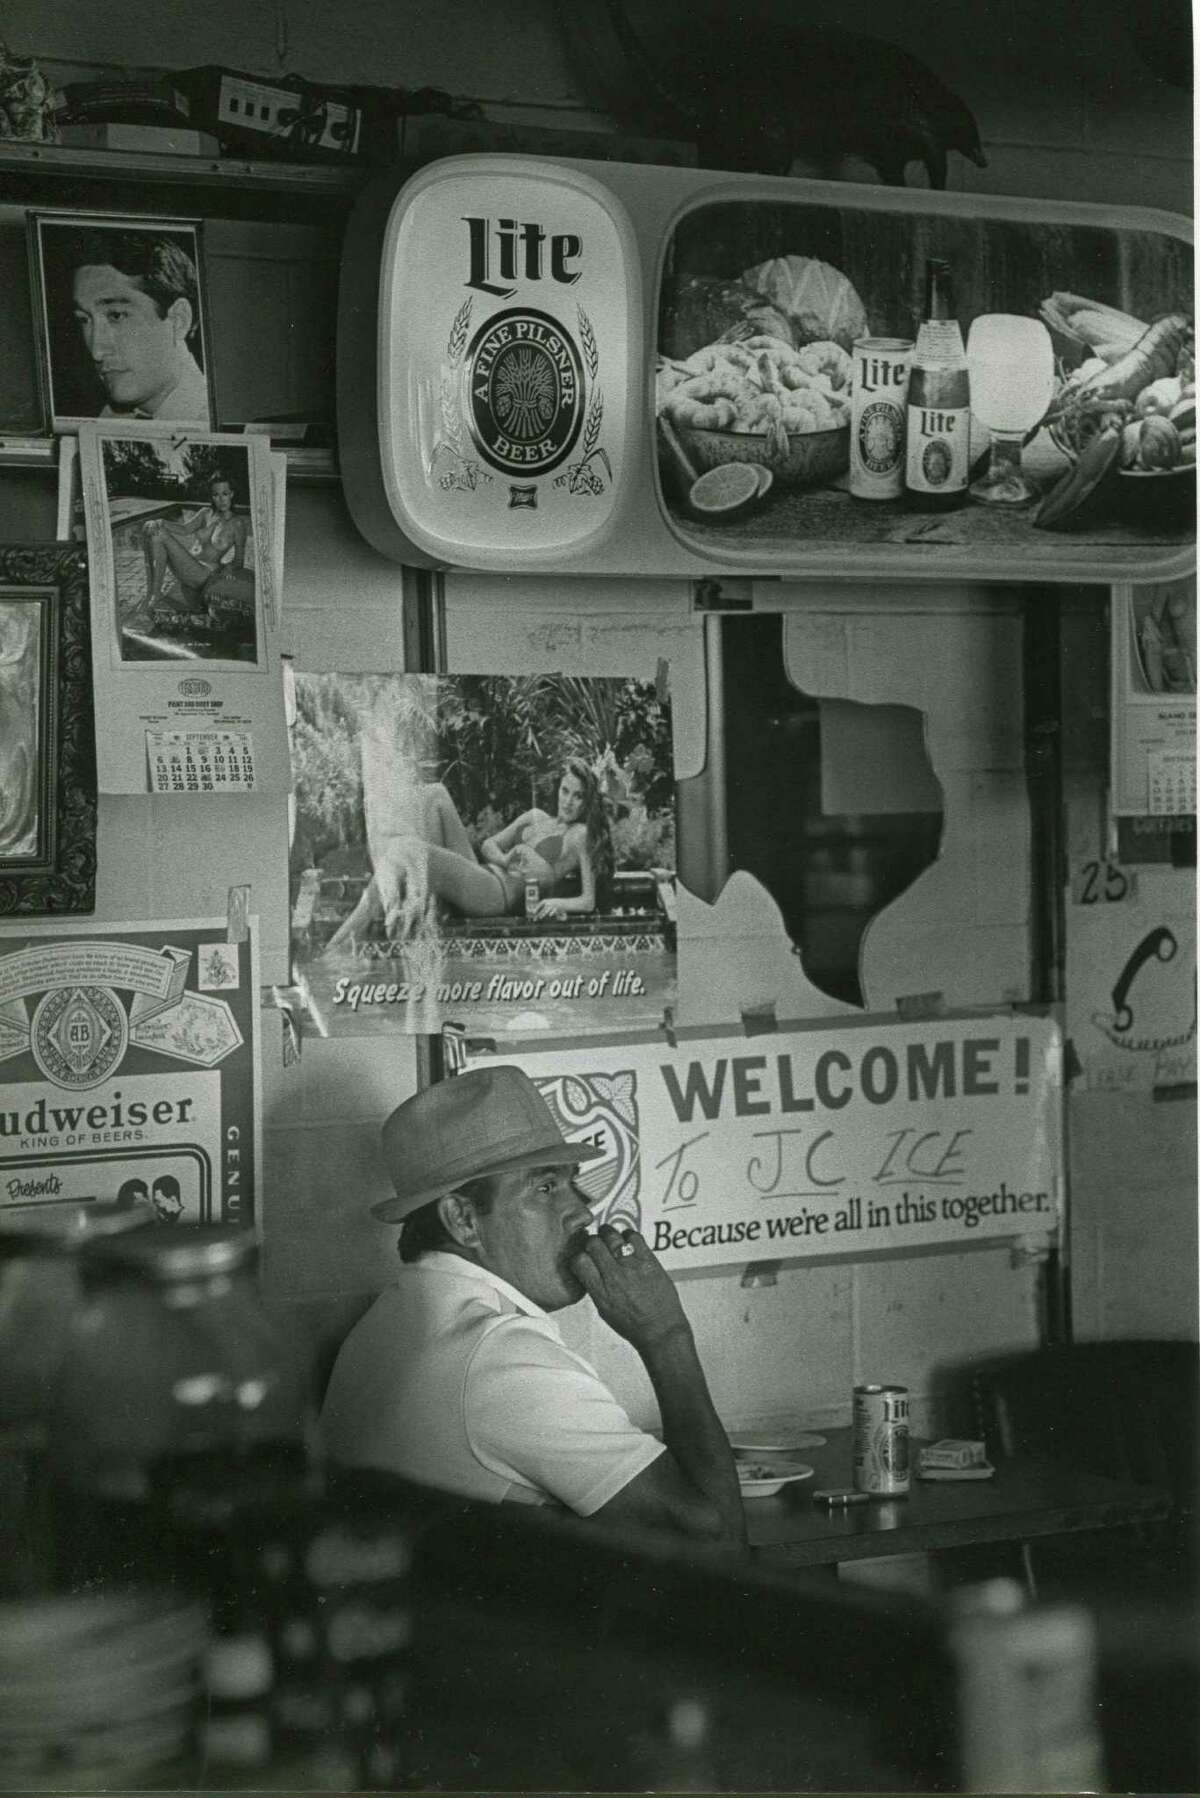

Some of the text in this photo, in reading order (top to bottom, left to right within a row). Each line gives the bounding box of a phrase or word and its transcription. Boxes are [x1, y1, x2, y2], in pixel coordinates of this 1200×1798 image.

[460, 217, 583, 299] Lite
[474, 322, 577, 408] A FINE PILSNER
[860, 357, 905, 392] Lite
[920, 410, 956, 437] Lite
[491, 435, 557, 462] BEER
[214, 756, 224, 764] 10
[229, 756, 238, 764] 11
[242, 756, 252, 764] 12
[229, 747, 235, 755] 4
[157, 765, 167, 773] 13
[171, 765, 182, 773] 14
[186, 765, 196, 773] 15
[200, 765, 211, 773] 16
[158, 774, 254, 782] 20 21 22 24 25 26
[158, 783, 213, 791] 27 28 29 30
[333, 970, 646, 1011] Squeeze more flavor out of life.
[660, 1037, 1030, 1123] WELCOME!
[0, 1090, 192, 1136] udweiser
[20, 1135, 60, 1149] KING
[66, 1132, 87, 1145] OF
[656, 1132, 710, 1204] To
[872, 1128, 973, 1178] ICE
[5, 1171, 64, 1199] Presents
[653, 1182, 1050, 1250] Because we're all in this together.
